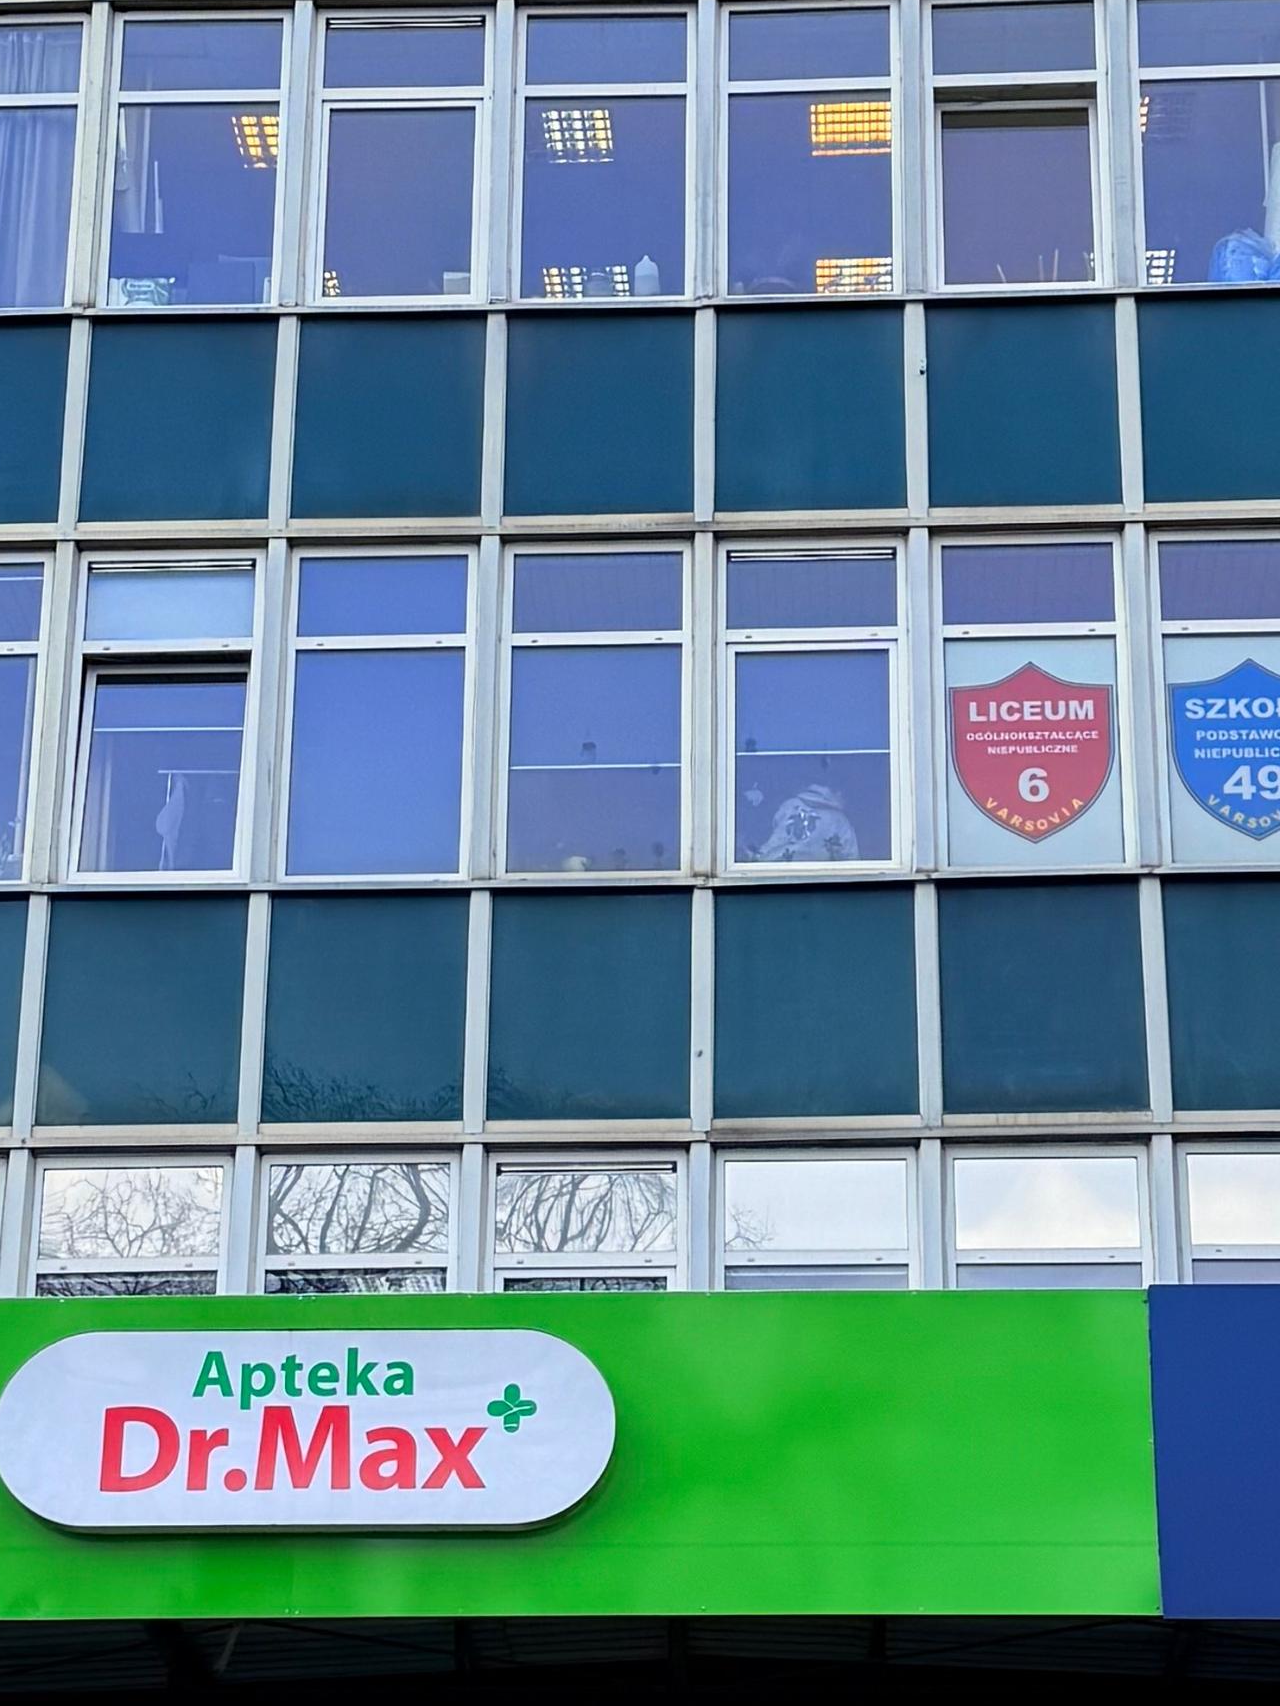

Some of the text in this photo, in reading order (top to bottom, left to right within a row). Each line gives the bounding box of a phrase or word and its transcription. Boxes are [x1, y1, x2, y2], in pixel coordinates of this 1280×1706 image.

[969, 700, 1095, 722] LICEUM
[987, 745, 1078, 755] NIEPUBLICZNE
[1018, 767, 1050, 802] 6
[985, 797, 1084, 831] VARSOVIA
[192, 1348, 414, 1409] Apteka
[99, 1405, 488, 1492] Dr.Max
